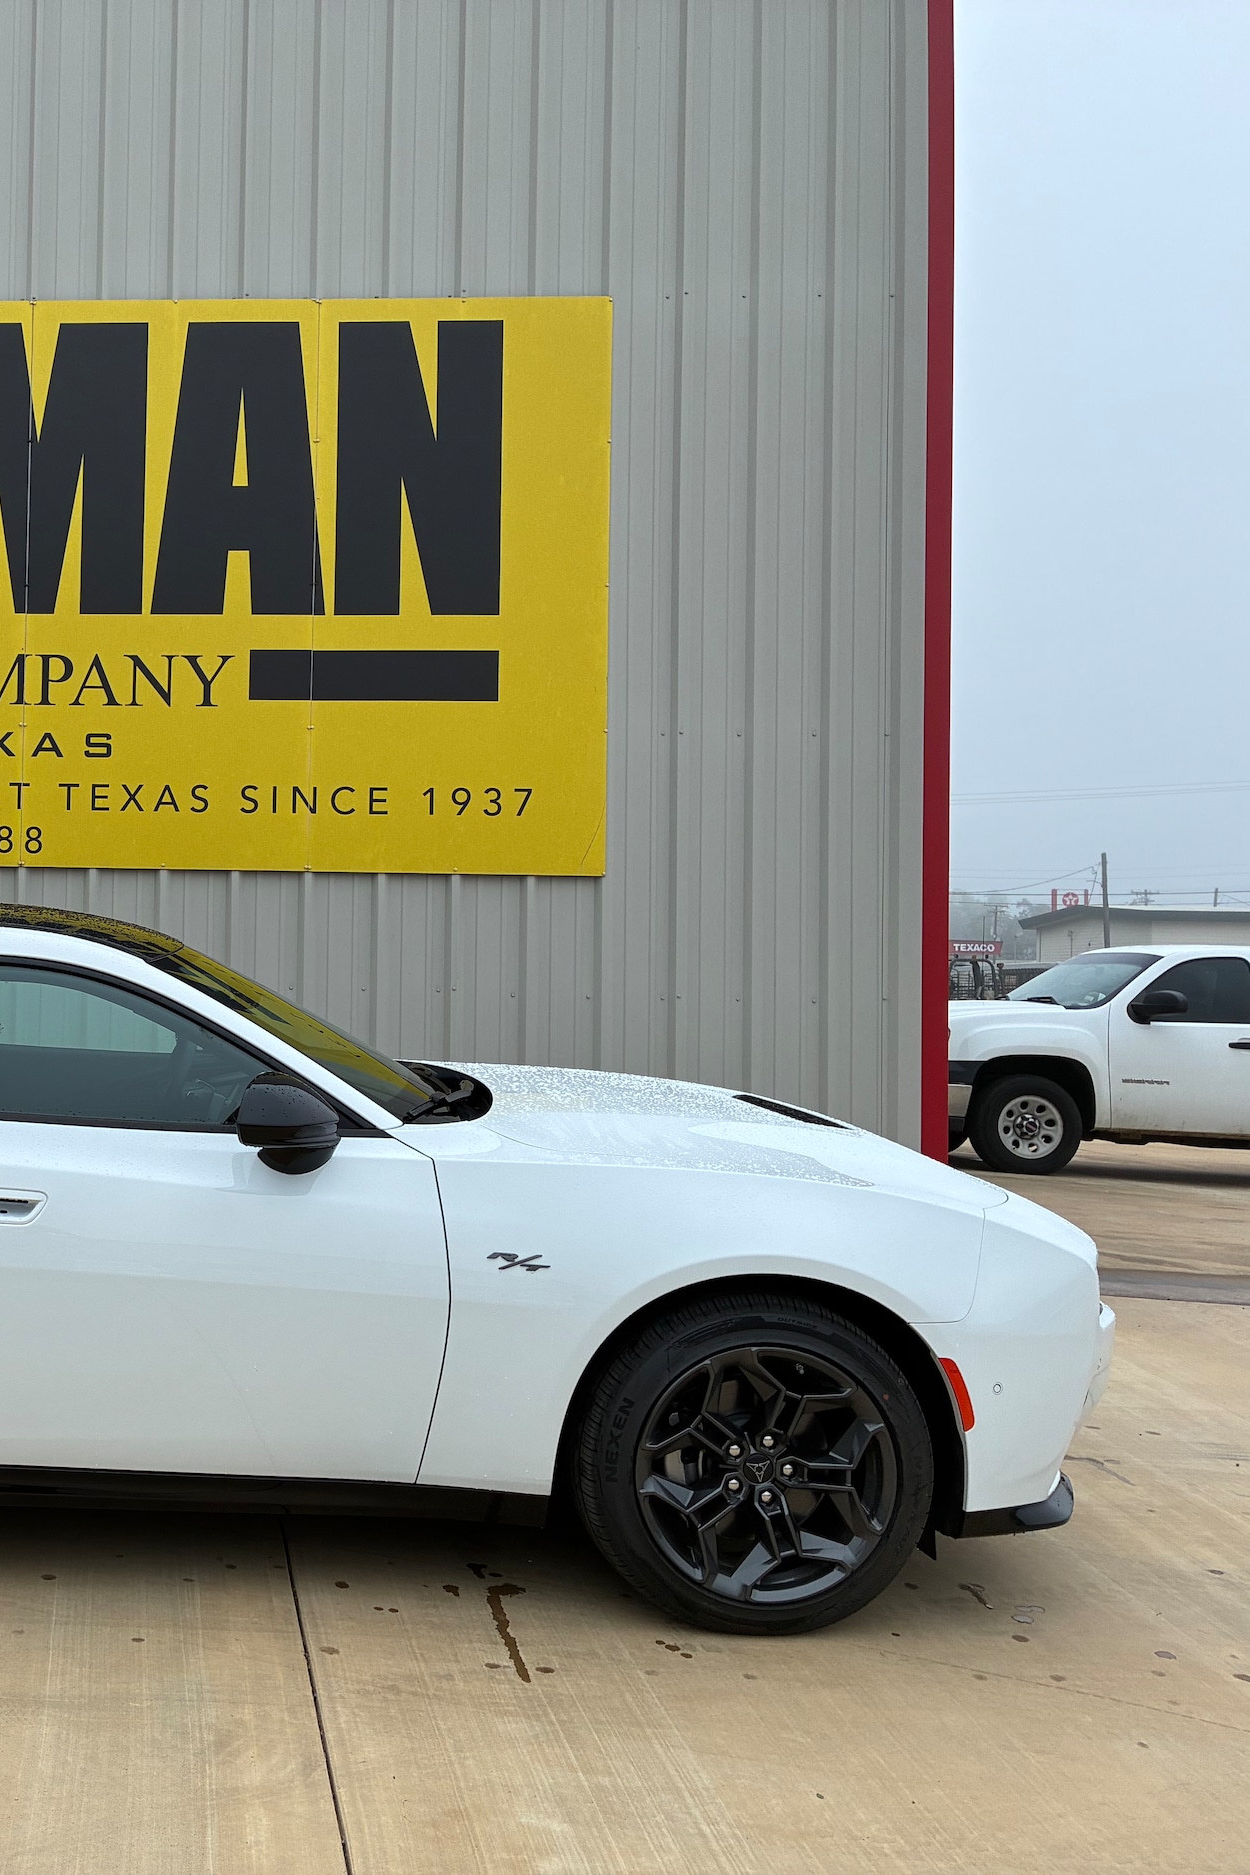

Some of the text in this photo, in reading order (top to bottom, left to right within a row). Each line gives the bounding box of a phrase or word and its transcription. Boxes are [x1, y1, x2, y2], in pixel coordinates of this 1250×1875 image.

[58, 783, 210, 814] TEXAS
[239, 785, 390, 816] SINCE
[422, 787, 534, 818] 1937
[953, 943, 996, 953] TEXACO
[604, 1396, 635, 1483] NEXEN
